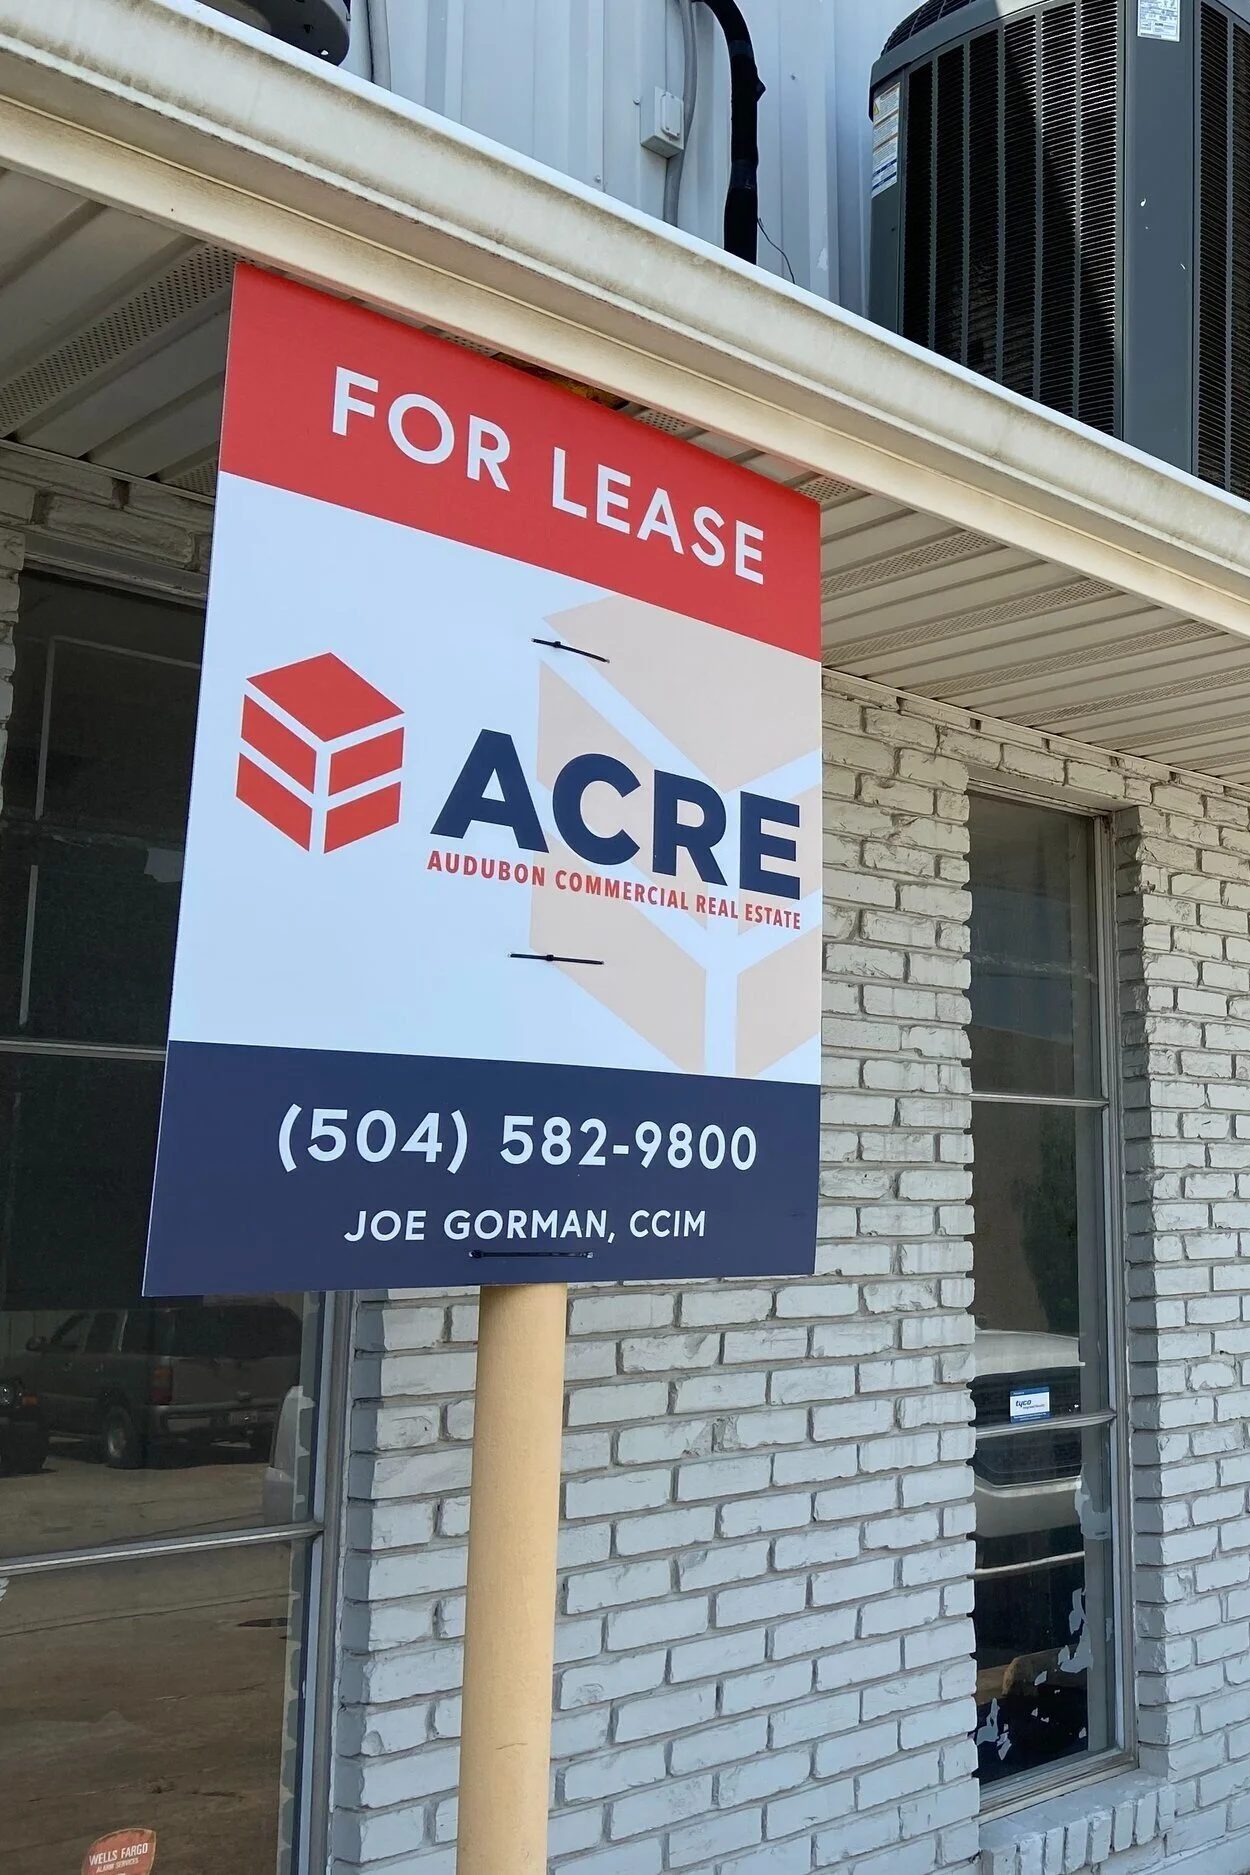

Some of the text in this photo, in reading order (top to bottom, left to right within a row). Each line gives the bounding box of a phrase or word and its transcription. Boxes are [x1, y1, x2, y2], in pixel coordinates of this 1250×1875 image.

[332, 366, 764, 585] FOR LEASE
[430, 728, 800, 900] ACRE
[427, 850, 801, 930] AUDUBON COMMERCIAL REAL ESTATE
[278, 1103, 757, 1174] (504) 582-9800
[344, 1209, 706, 1244] JOE GORMAN, CCIM
[1015, 1399, 1032, 1408] tyco
[89, 1842, 149, 1866] WELLS FARGO
